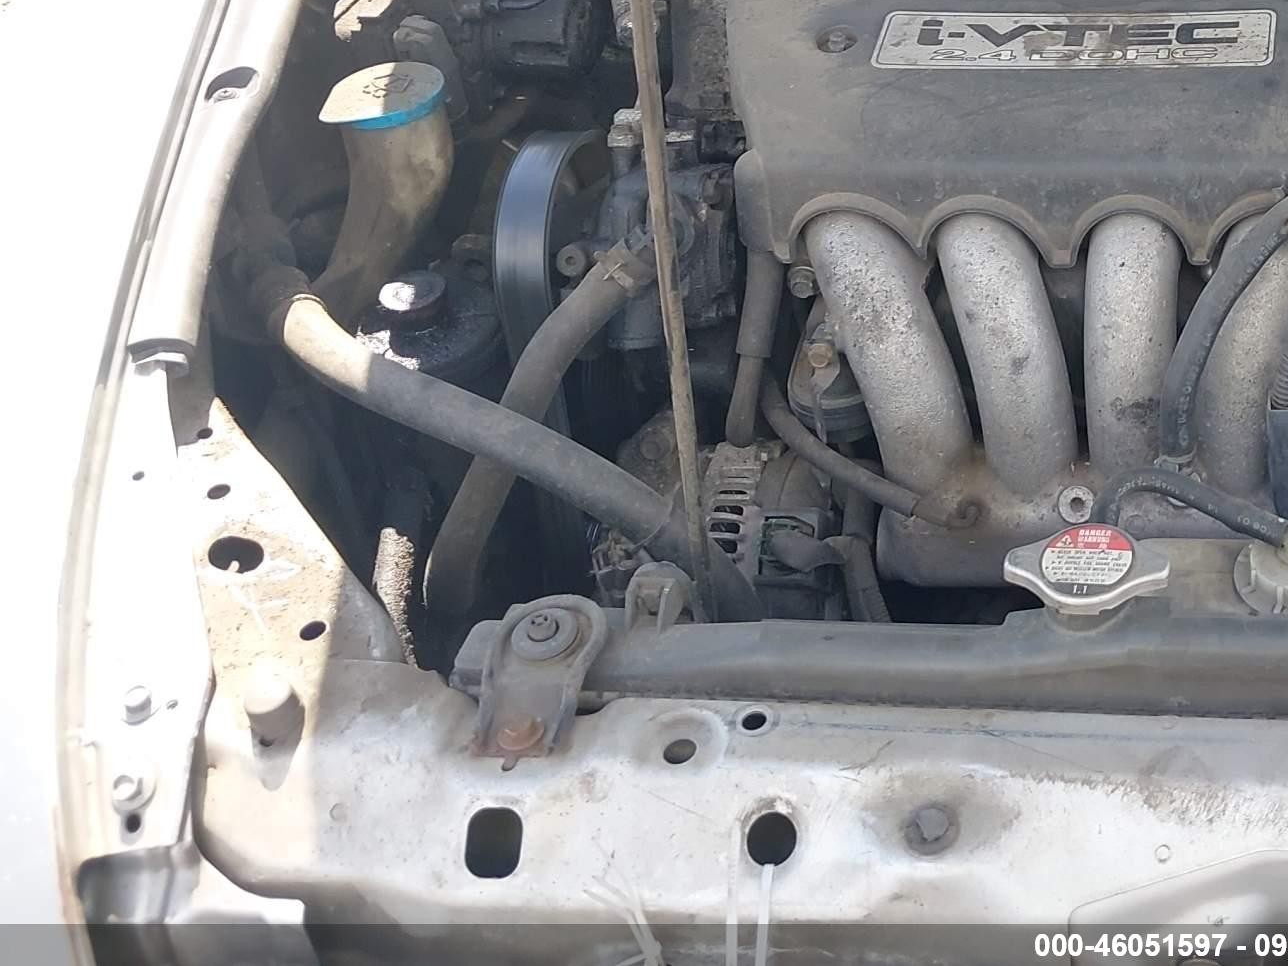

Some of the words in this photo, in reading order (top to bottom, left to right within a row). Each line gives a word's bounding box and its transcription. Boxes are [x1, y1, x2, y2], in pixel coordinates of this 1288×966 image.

[916, 19, 1241, 47] i-VTEC
[929, 48, 1017, 62] 2.4
[1028, 46, 1219, 62] DOHC
[1072, 585, 1088, 594] 1.1
